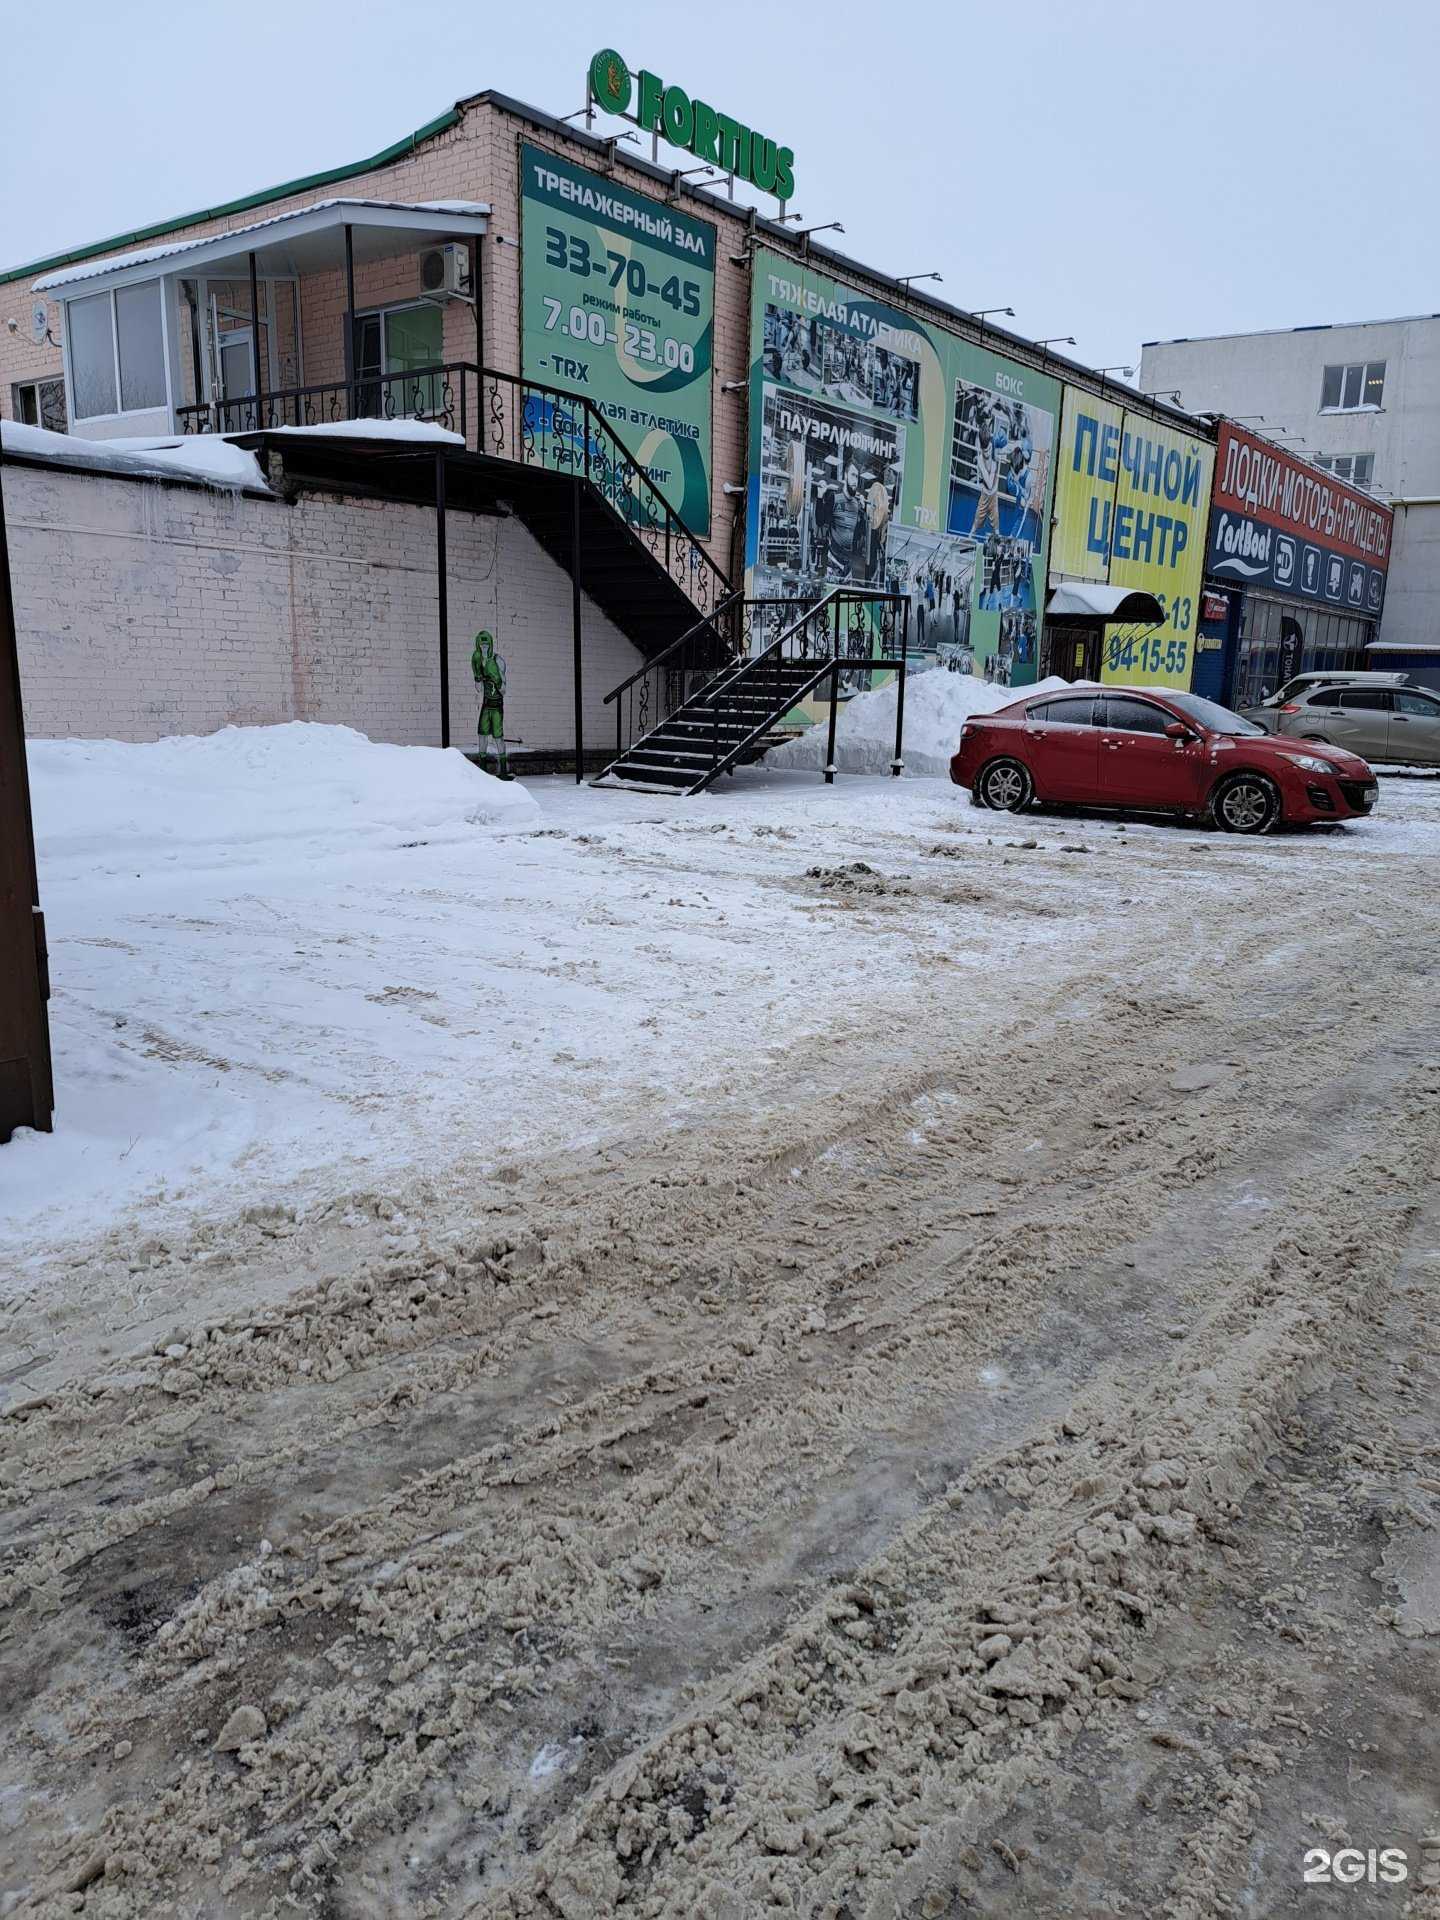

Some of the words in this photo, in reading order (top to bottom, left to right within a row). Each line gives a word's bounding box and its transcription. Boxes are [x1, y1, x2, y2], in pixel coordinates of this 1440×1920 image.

[638, 69, 794, 201] FORTIUS
[534, 165, 672, 243] ТРЕНАЖЕРНЫЙ
[675, 229, 706, 257] ЗАЛ
[545, 226, 700, 317] 33-70-45
[582, 293, 621, 315] режим
[622, 307, 661, 328] работы
[768, 274, 848, 323] ТЯЖЕЛАЯ
[850, 312, 922, 352] АТЛЕТИКА
[551, 354, 590, 384] TRX
[623, 322, 694, 373] 23.00
[995, 371, 1024, 397] БОКС
[630, 407, 700, 440] атлетика
[780, 410, 897, 458] ПАУЭРЛИФТИНГ
[1073, 413, 1202, 508] ПЕЧНОЙ
[1087, 496, 1189, 569] ЦЕНТР
[1108, 634, 1187, 674] 94-15-55
